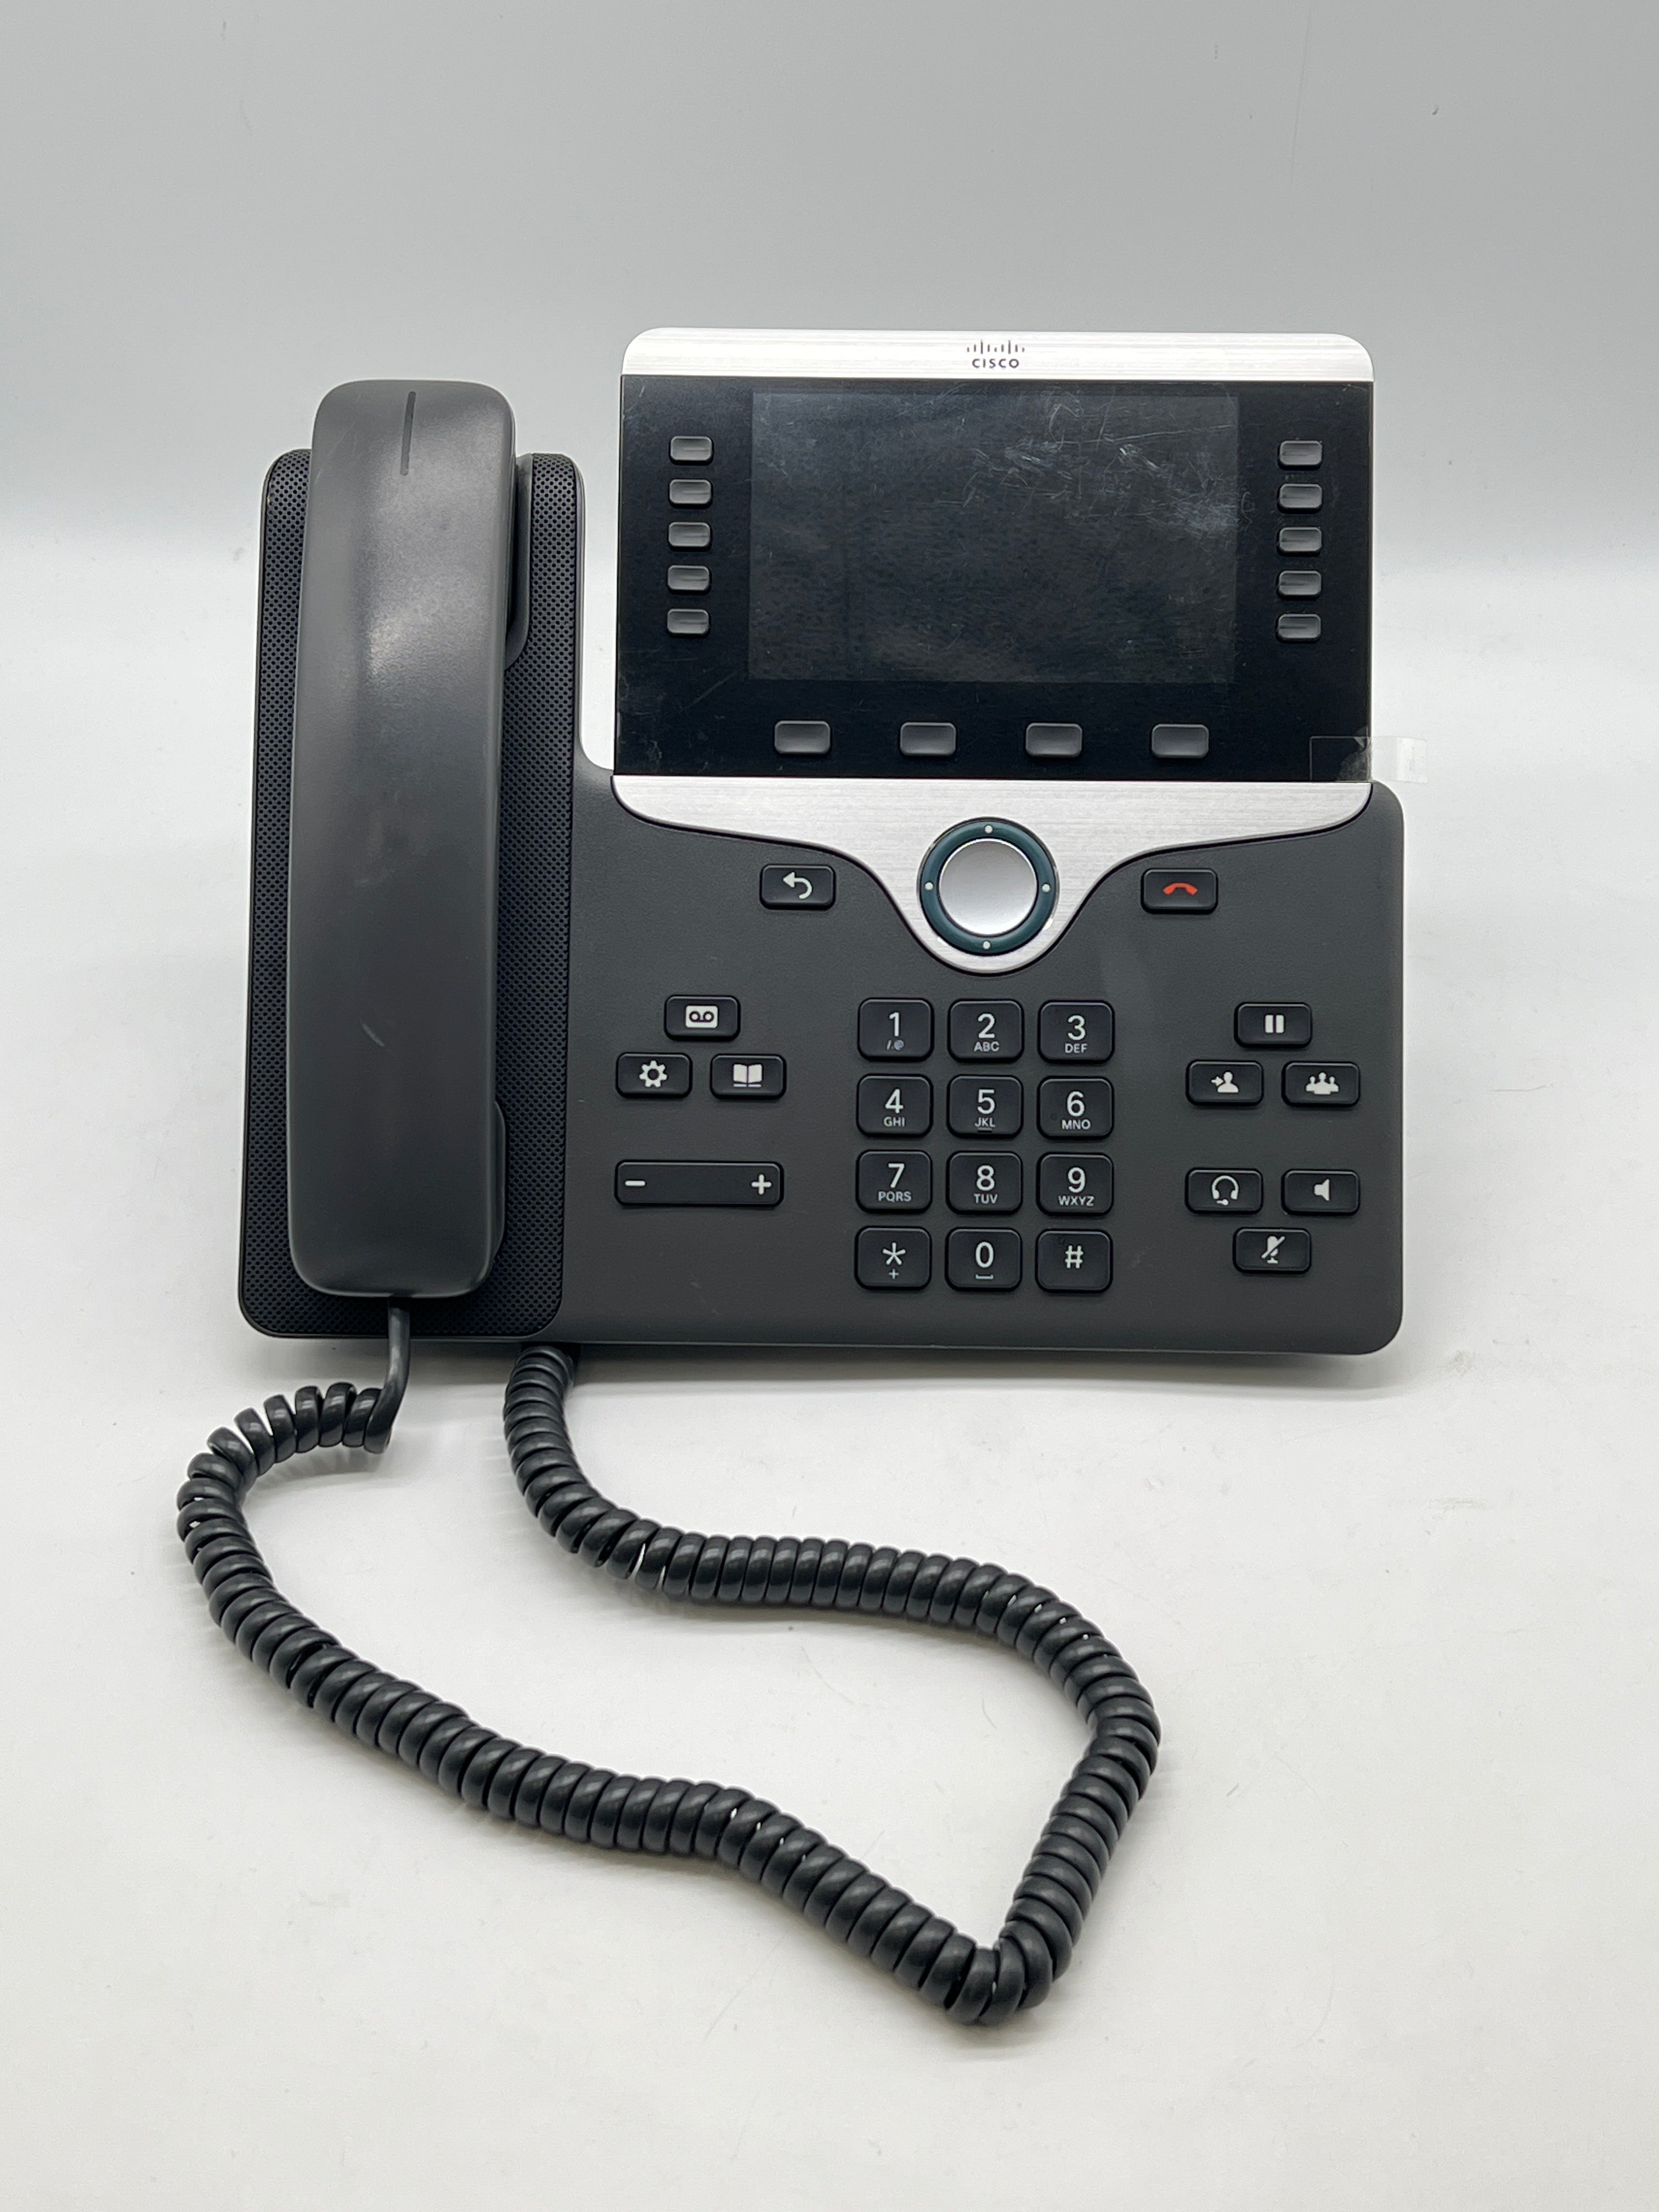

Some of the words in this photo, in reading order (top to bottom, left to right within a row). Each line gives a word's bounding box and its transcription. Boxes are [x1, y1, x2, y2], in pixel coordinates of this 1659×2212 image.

[972, 358, 1019, 368] CISCO
[890, 1012, 899, 1036] 1
[978, 1014, 995, 1038] 2
[1068, 1015, 1085, 1040] 3
[974, 1041, 999, 1051] ABC
[1065, 1043, 1087, 1053] DEF
[885, 1089, 903, 1113] 4
[978, 1090, 995, 1114] 5
[1068, 1092, 1084, 1116] 6
[884, 1117, 904, 1126] GHI
[975, 1118, 995, 1127] JKL
[1062, 1120, 1090, 1129] MNO
[889, 1164, 904, 1188] 7
[977, 1166, 994, 1190] 8
[1068, 1167, 1085, 1192] 9
[879, 1192, 911, 1202] PQRS
[974, 1194, 997, 1204] TUV
[1059, 1196, 1094, 1206] WXYZ
[976, 1242, 994, 1267] 0
[1065, 1246, 1083, 1268] #
